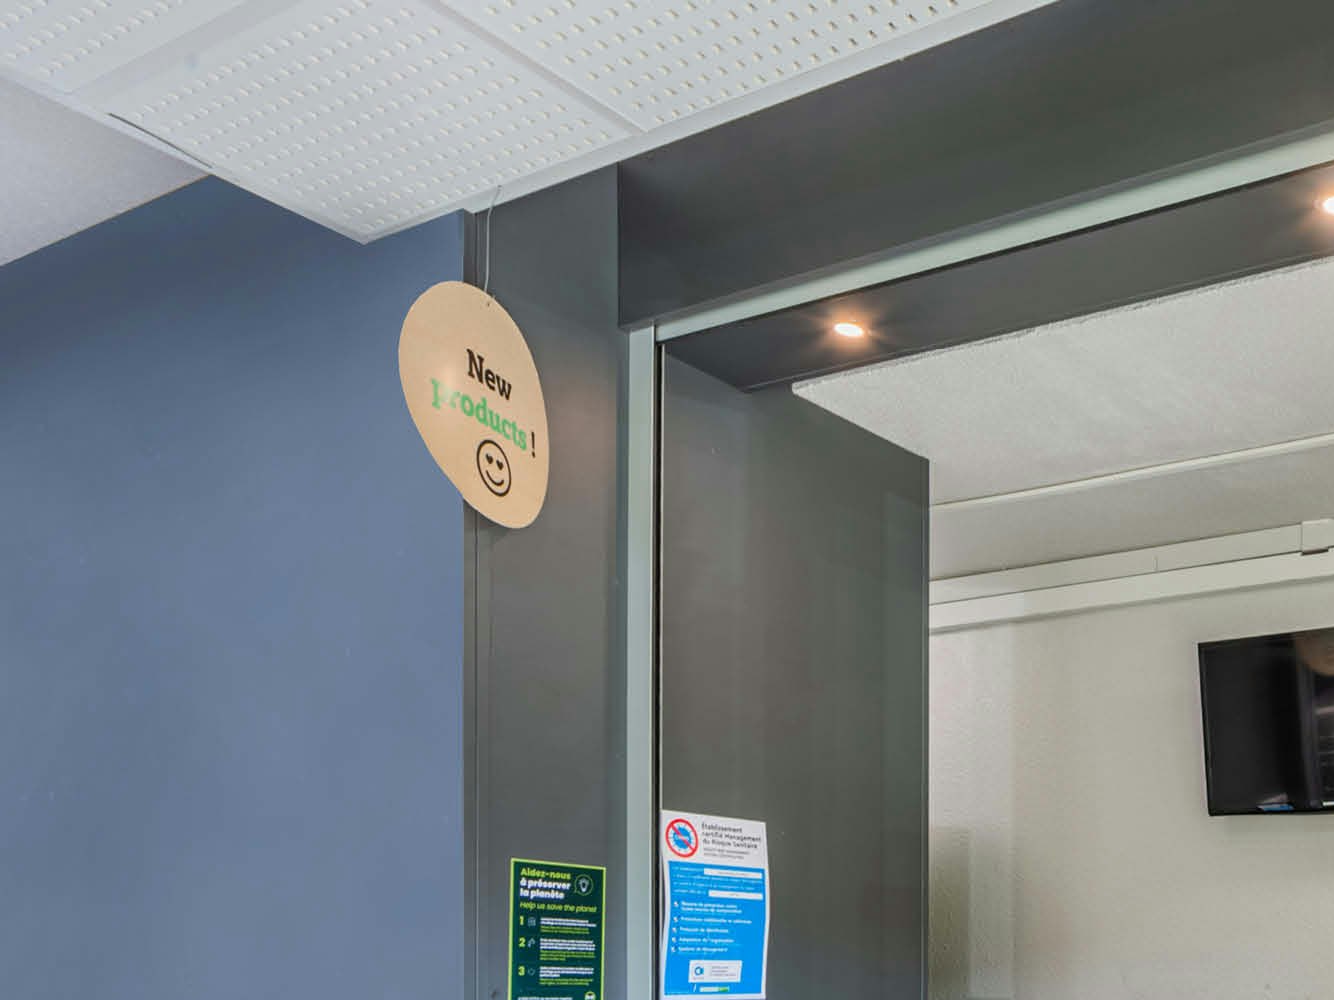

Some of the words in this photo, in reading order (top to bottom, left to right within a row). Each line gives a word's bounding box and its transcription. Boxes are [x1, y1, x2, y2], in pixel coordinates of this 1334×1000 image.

[466, 348, 512, 400] New
[724, 833, 761, 842] Management
[521, 868, 571, 879] Aidez-nous
[527, 878, 571, 890] préserver
[520, 888, 529, 896] la
[530, 889, 564, 899] planète
[520, 902, 536, 911] Help
[519, 916, 524, 925] 1
[518, 938, 525, 947] 2
[518, 966, 525, 975] 3
